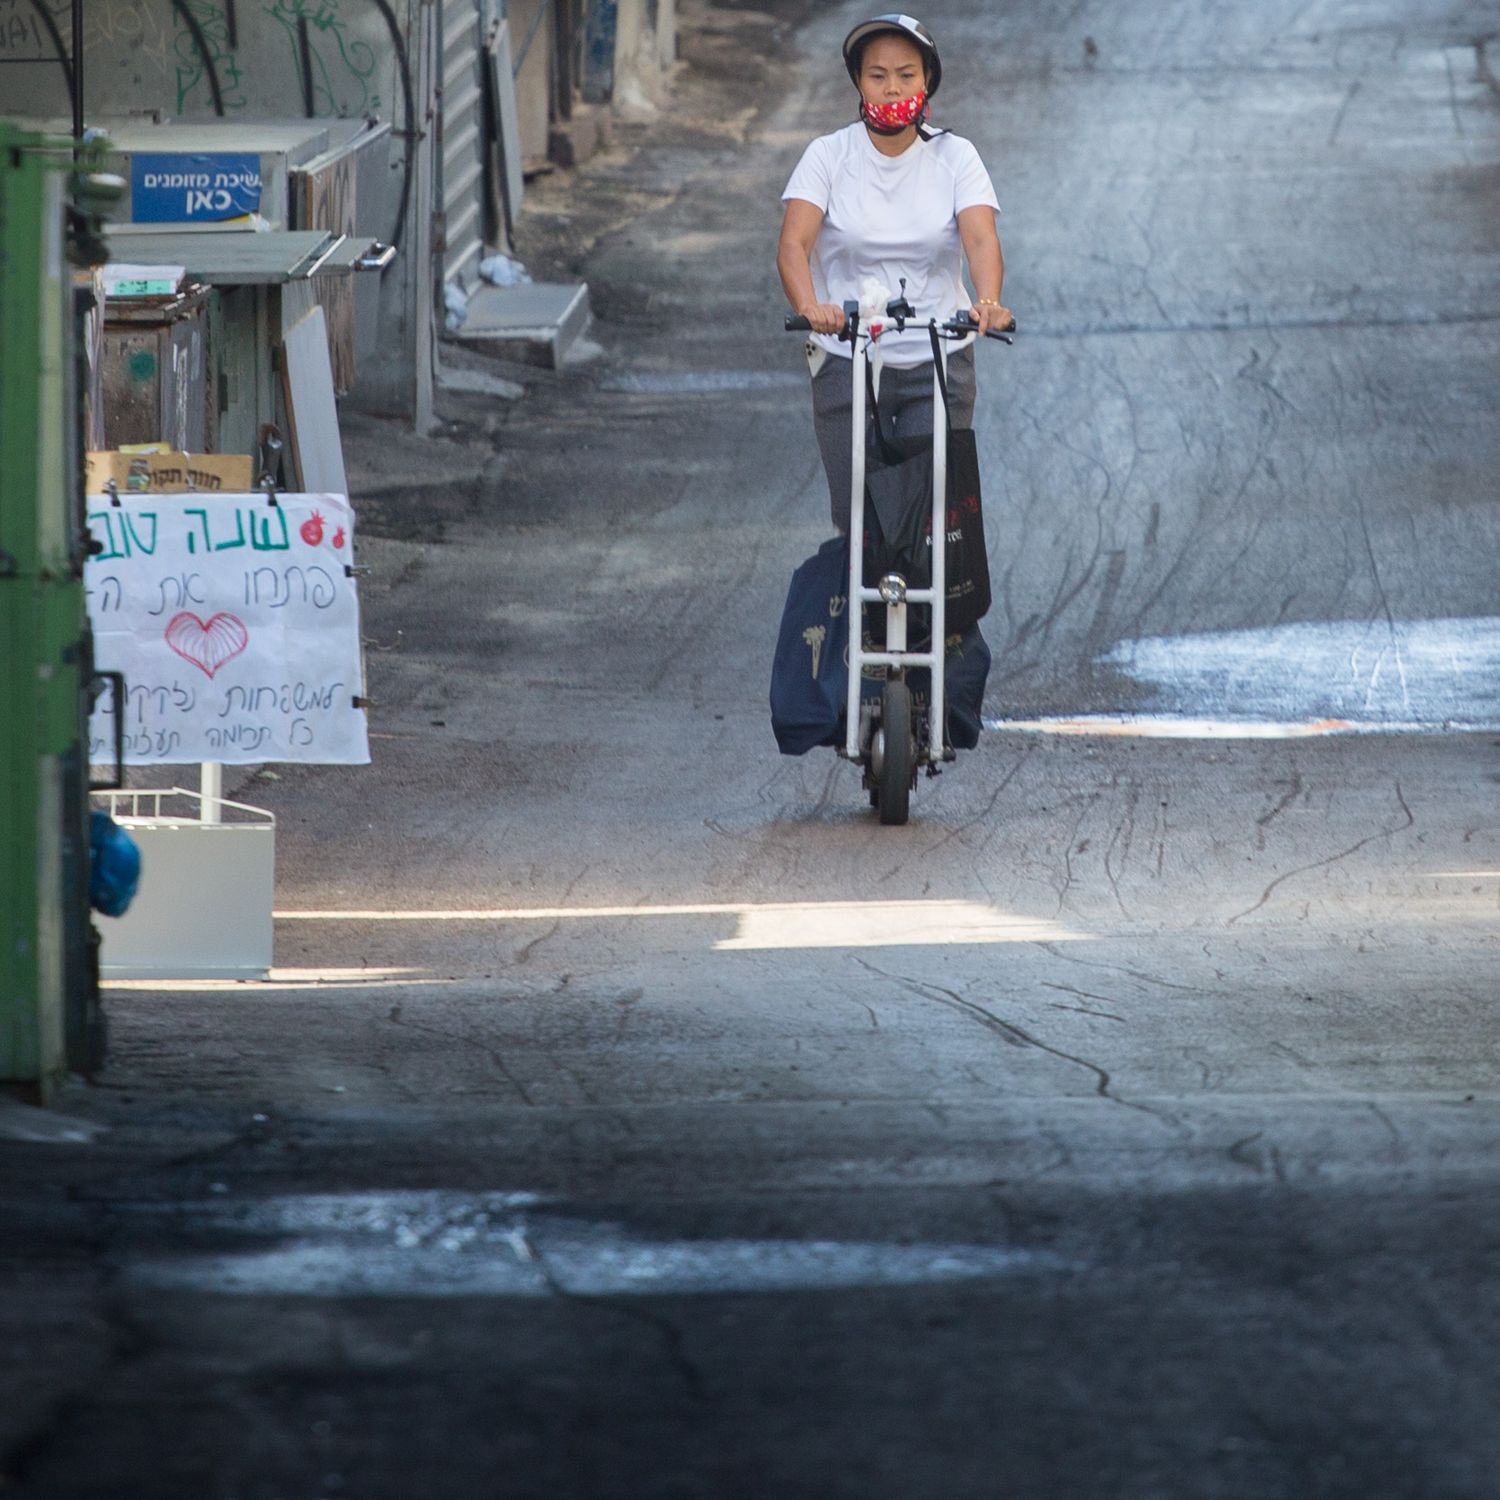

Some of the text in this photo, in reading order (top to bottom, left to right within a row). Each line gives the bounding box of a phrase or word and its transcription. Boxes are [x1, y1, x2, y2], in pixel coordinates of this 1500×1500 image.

[143, 173, 263, 189] שיכת מזומנים
[185, 189, 232, 215] כאן
[86, 505, 290, 562] שנה טוב
[148, 571, 205, 616] את
[244, 565, 336, 609] פתחו
[217, 681, 345, 718] למשפחות
[204, 723, 272, 751] תרומה
[288, 717, 314, 746] כל
